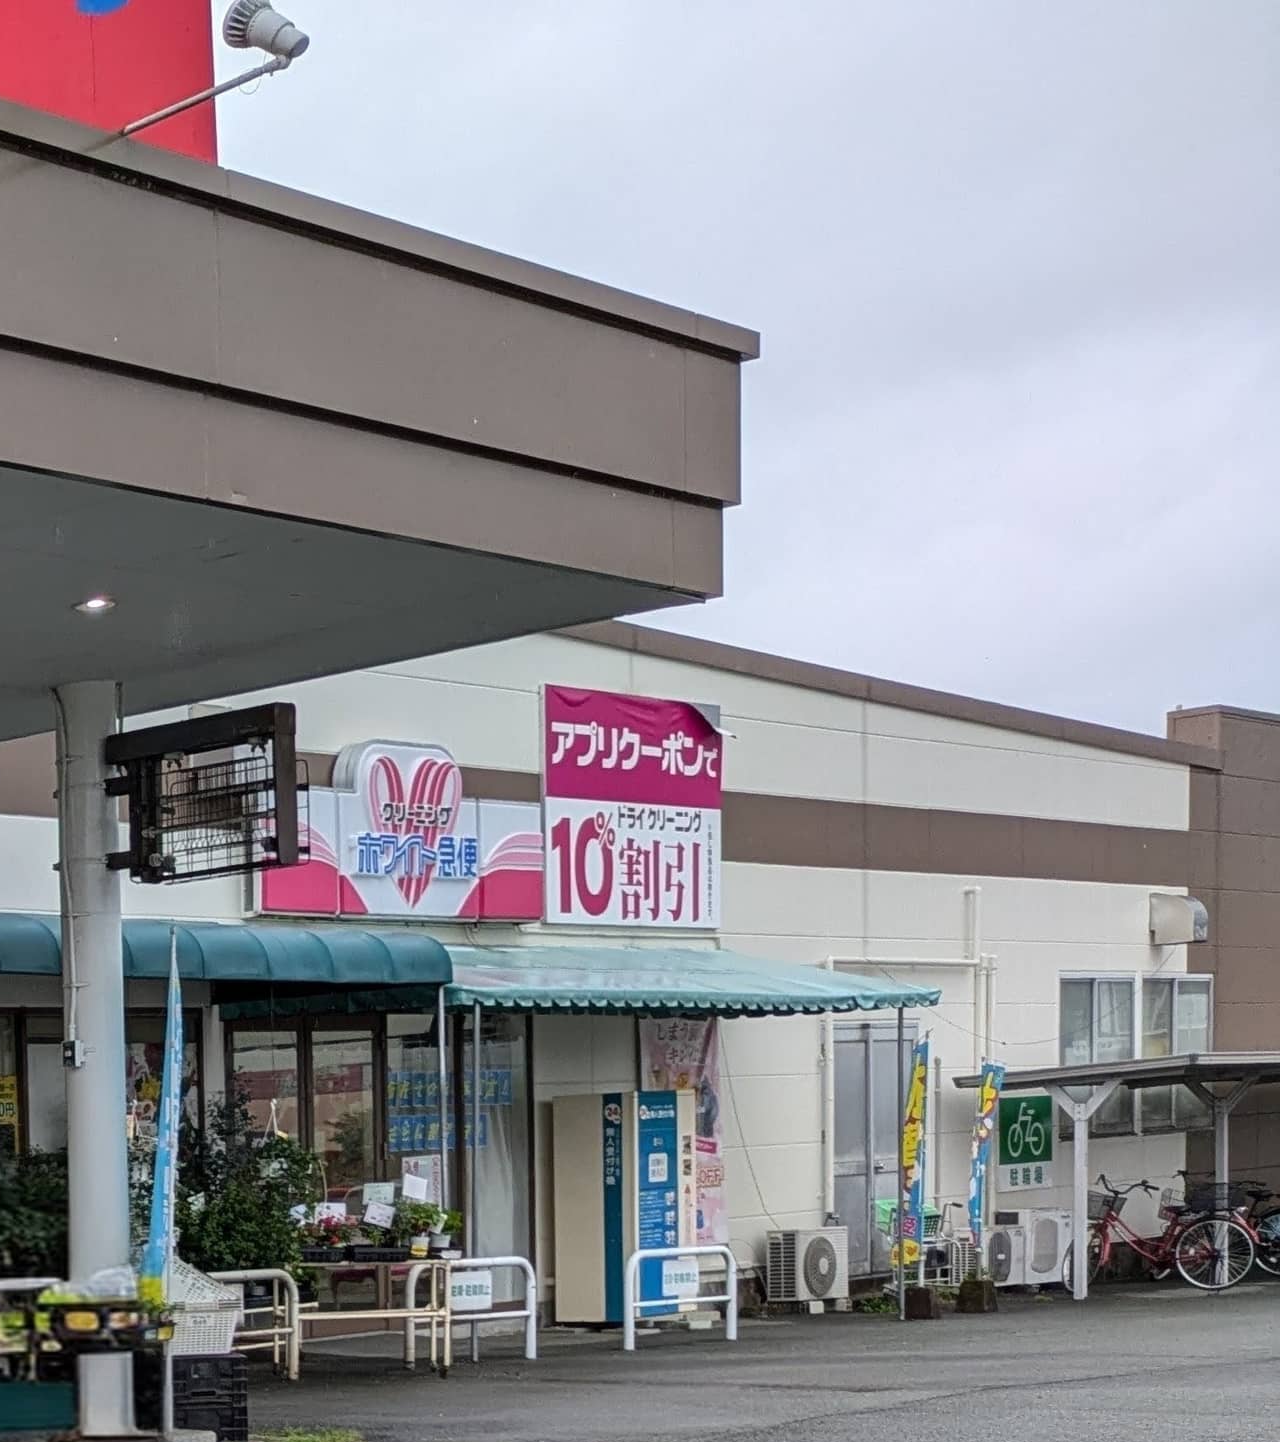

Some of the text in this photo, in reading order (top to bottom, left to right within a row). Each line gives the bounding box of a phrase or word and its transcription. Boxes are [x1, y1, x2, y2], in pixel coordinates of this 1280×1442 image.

[550, 721, 717, 779] アプリクーポンで
[381, 801, 453, 827] クリーニング
[617, 805, 702, 832] ドライクリーニング
[357, 831, 477, 877] ホワイト急便
